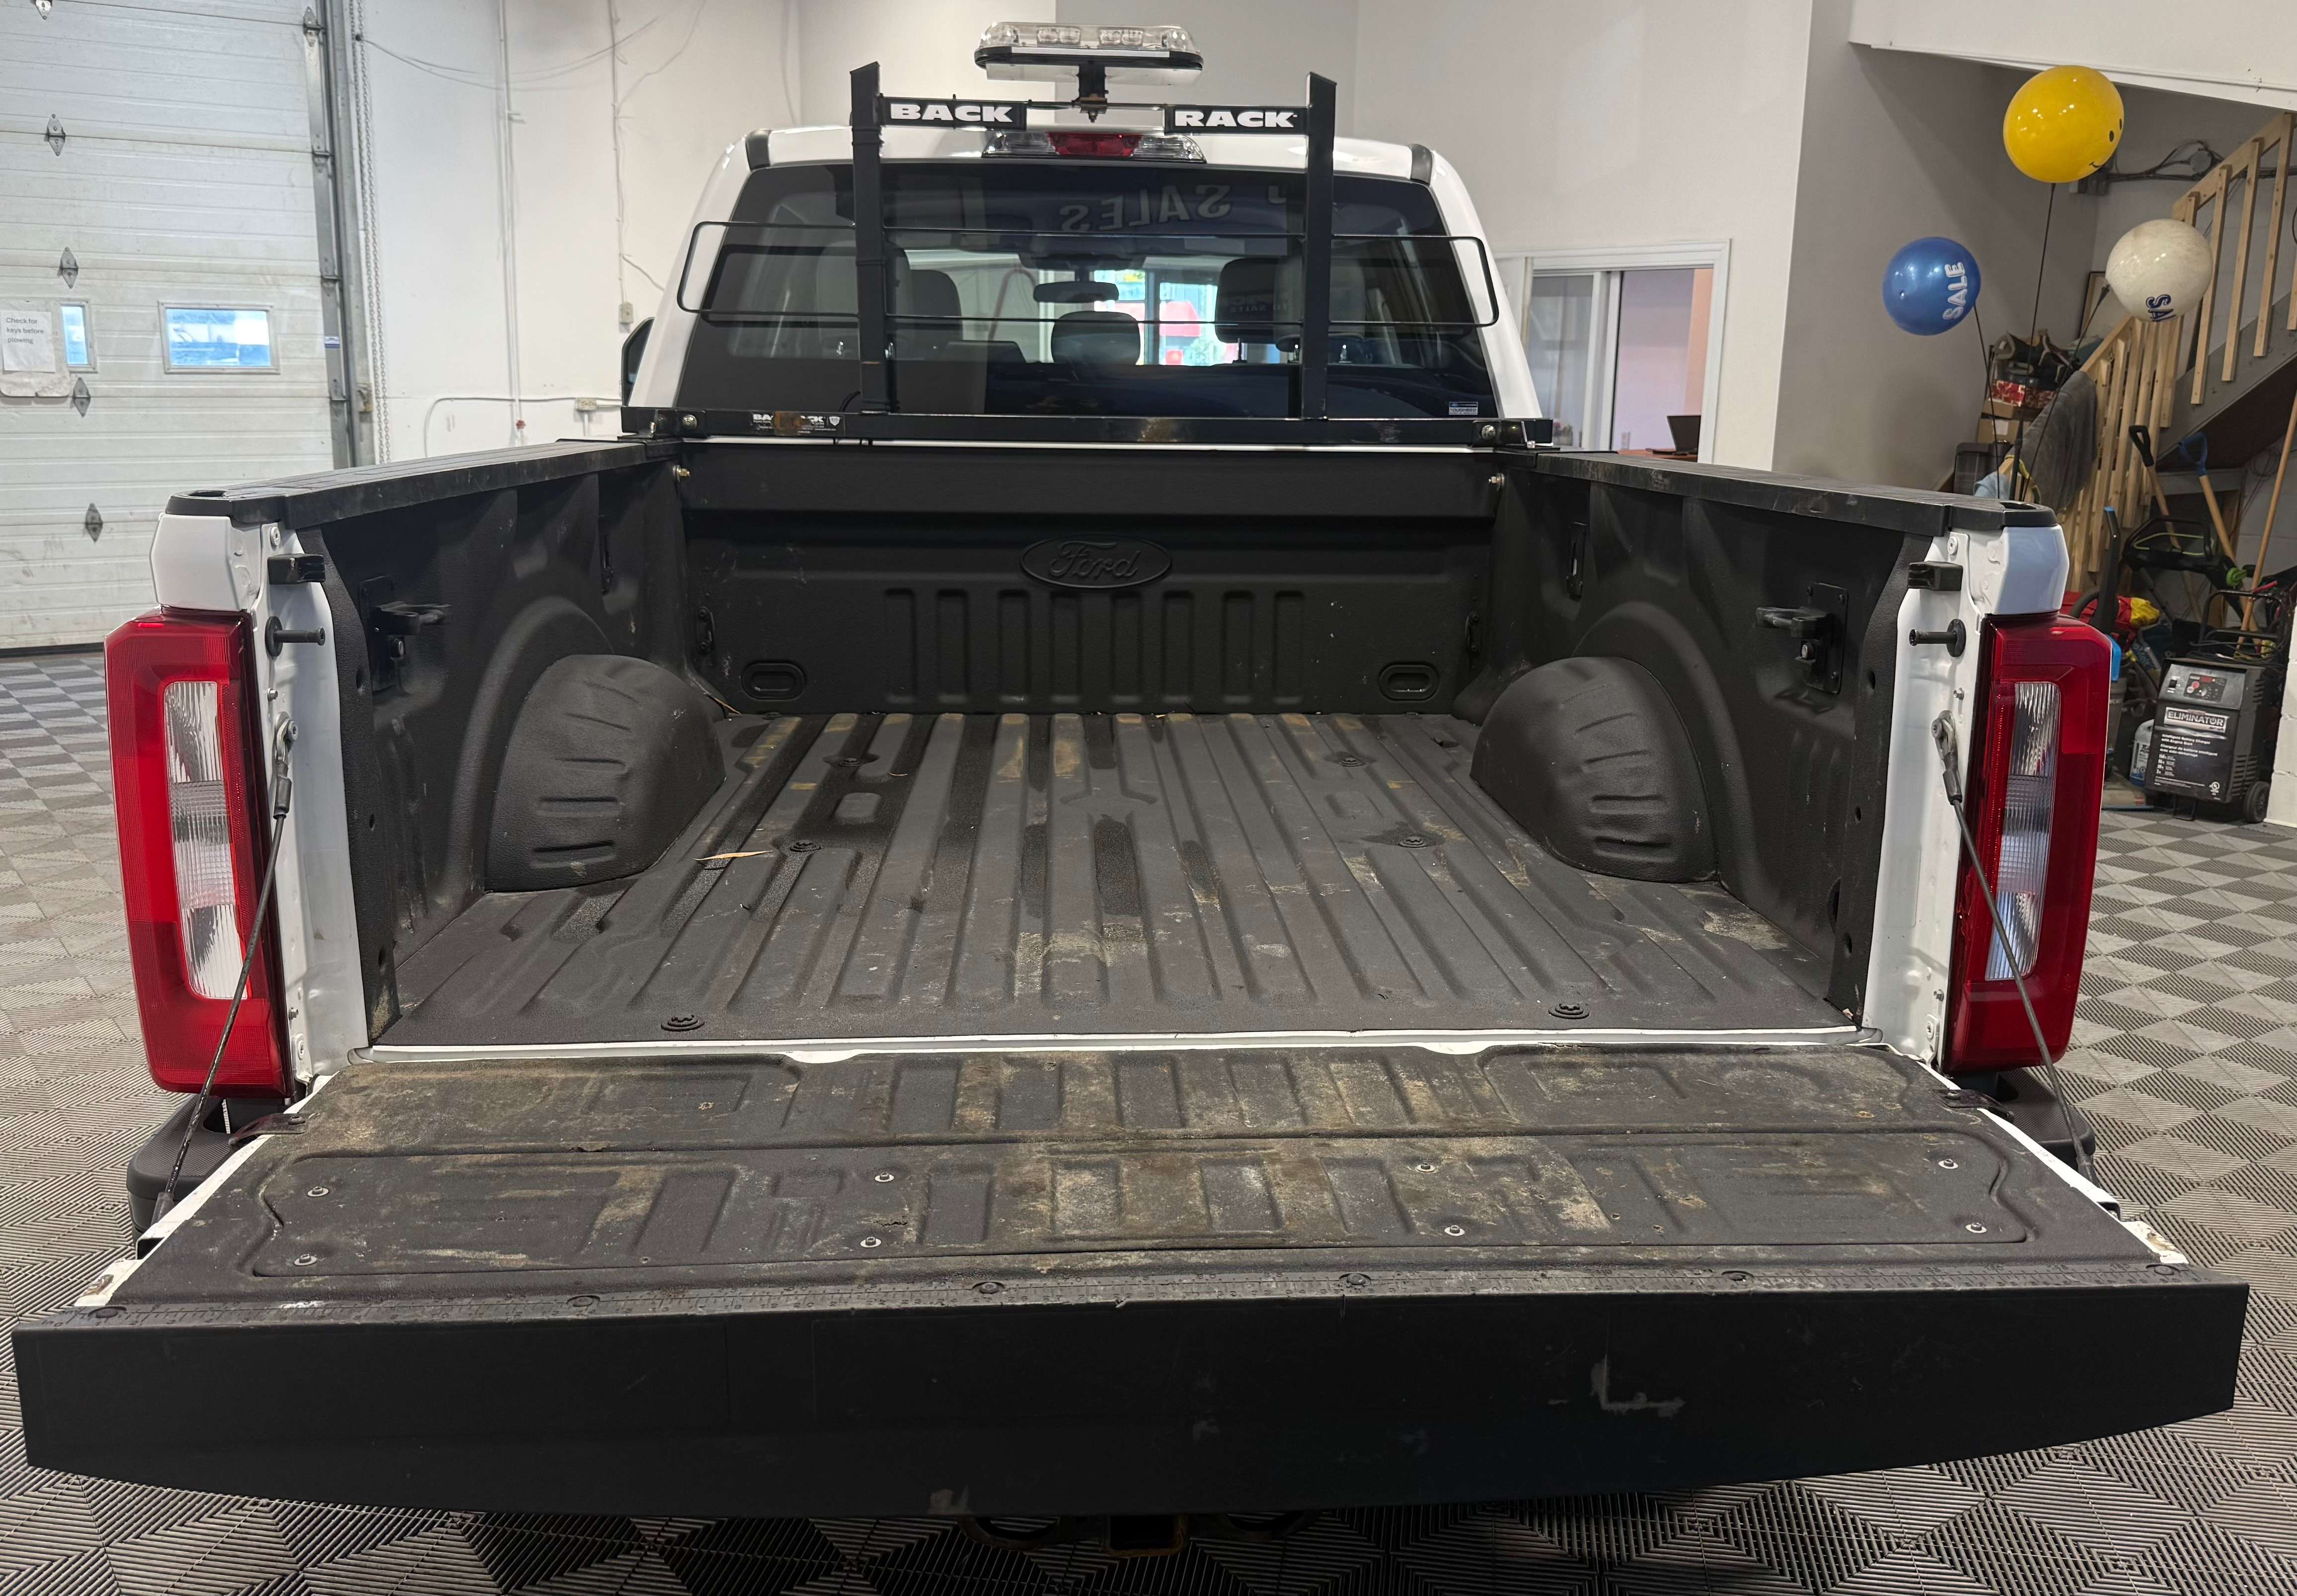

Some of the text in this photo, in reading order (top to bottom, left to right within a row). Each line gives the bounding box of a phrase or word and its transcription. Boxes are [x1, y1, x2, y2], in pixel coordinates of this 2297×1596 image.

[890, 103, 1294, 128] BACK RACK
[1942, 262, 1968, 320] SALE
[1049, 540, 1141, 578] Ford
[2167, 711, 2224, 726] ELIMINATOR
